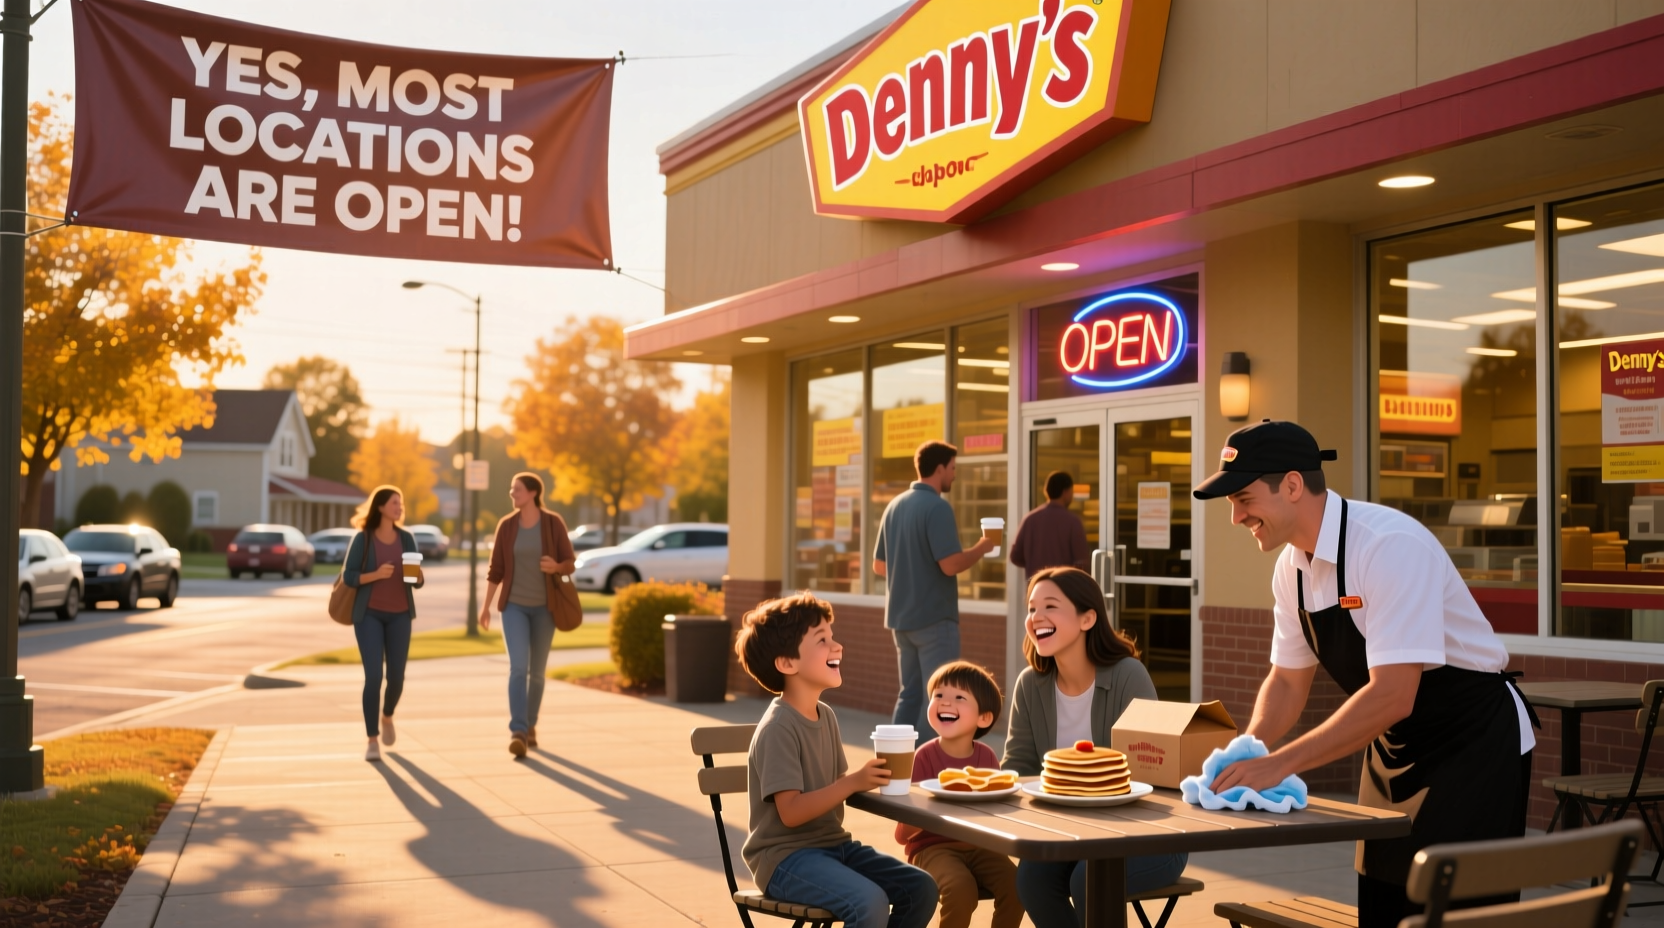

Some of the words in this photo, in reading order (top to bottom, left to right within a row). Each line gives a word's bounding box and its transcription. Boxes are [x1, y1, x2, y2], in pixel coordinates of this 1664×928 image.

[181, 36, 319, 112] YES,
[337, 61, 514, 122] MOST
[823, 0, 1099, 191] Denny's
[169, 97, 535, 184] LOCATIONS
[183, 165, 317, 227] ARE
[334, 180, 522, 243] OPEN!
[1060, 310, 1172, 373] OPEN
